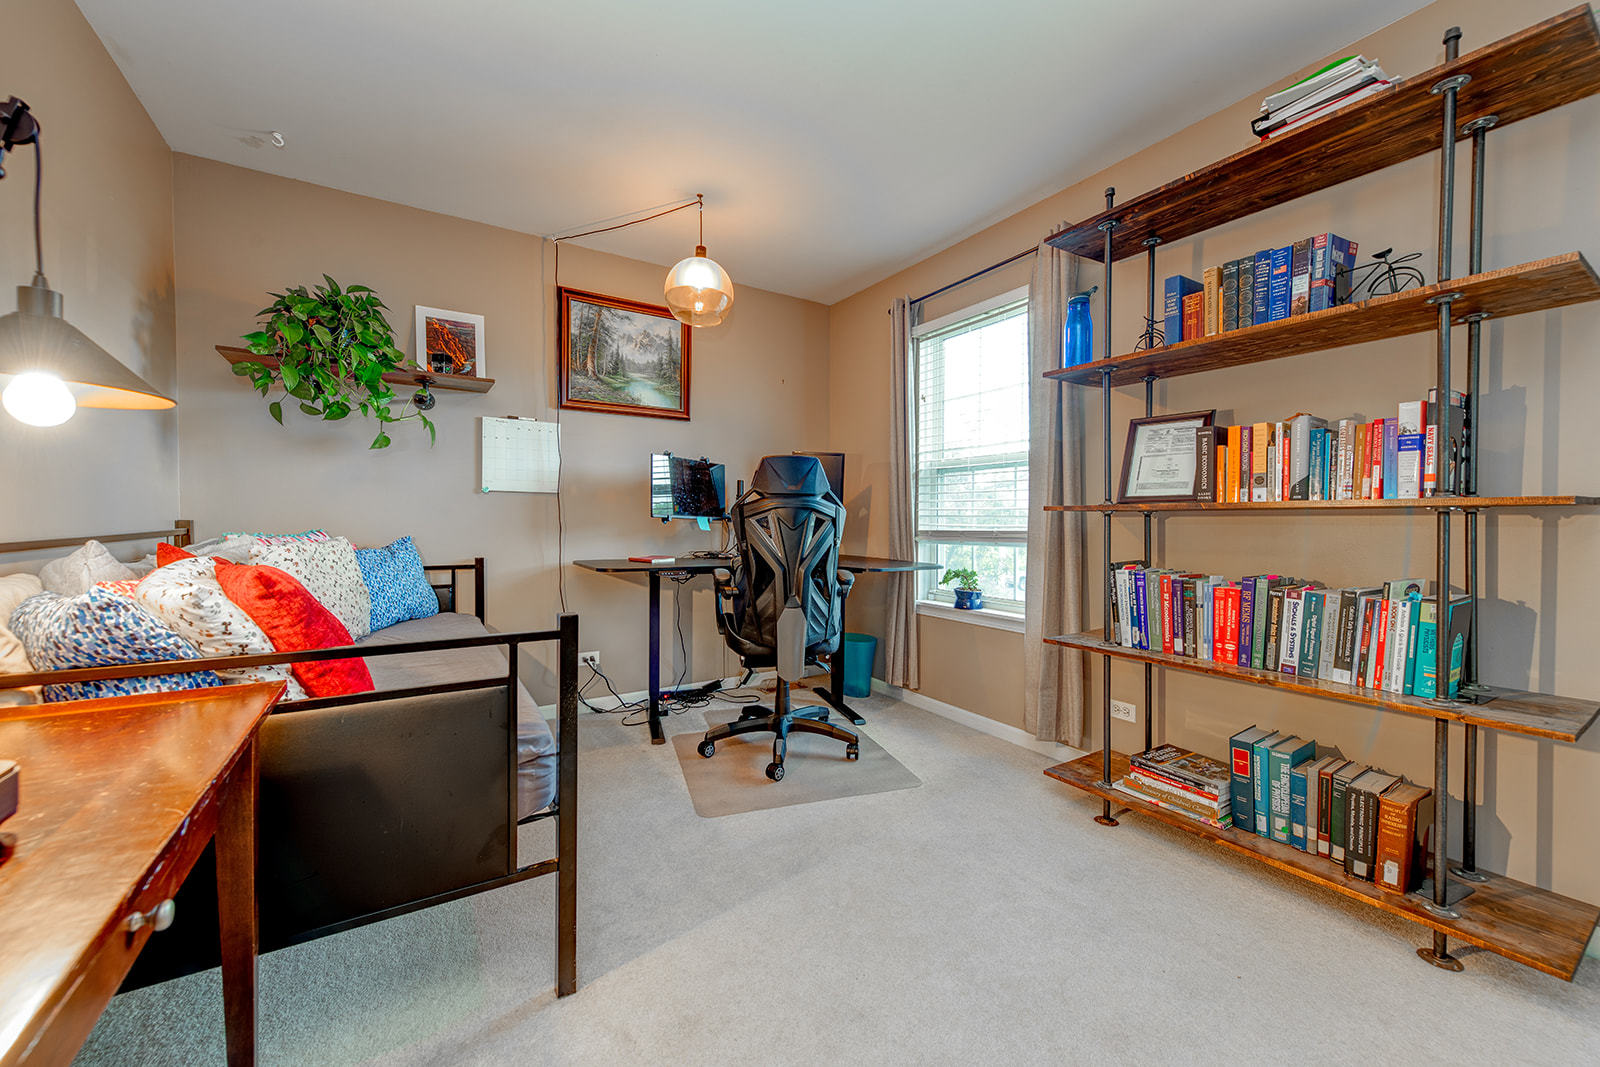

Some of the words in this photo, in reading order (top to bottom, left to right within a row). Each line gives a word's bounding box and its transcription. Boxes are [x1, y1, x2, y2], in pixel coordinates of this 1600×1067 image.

[1243, 590, 1251, 600] RF
[1242, 602, 1250, 623] MEMS
[1291, 601, 1299, 626] SIGNALS
[1379, 611, 1387, 642] Electromagnetics
[1390, 620, 1396, 628] ON
[1288, 632, 1297, 658] SYSTEMS
[1281, 763, 1289, 774] THE
[1272, 780, 1280, 788] OF
[1281, 774, 1289, 814] ENCYCLOPEDIA
[1272, 788, 1280, 812] PHYSICS
[1384, 814, 1402, 822] RADIO
